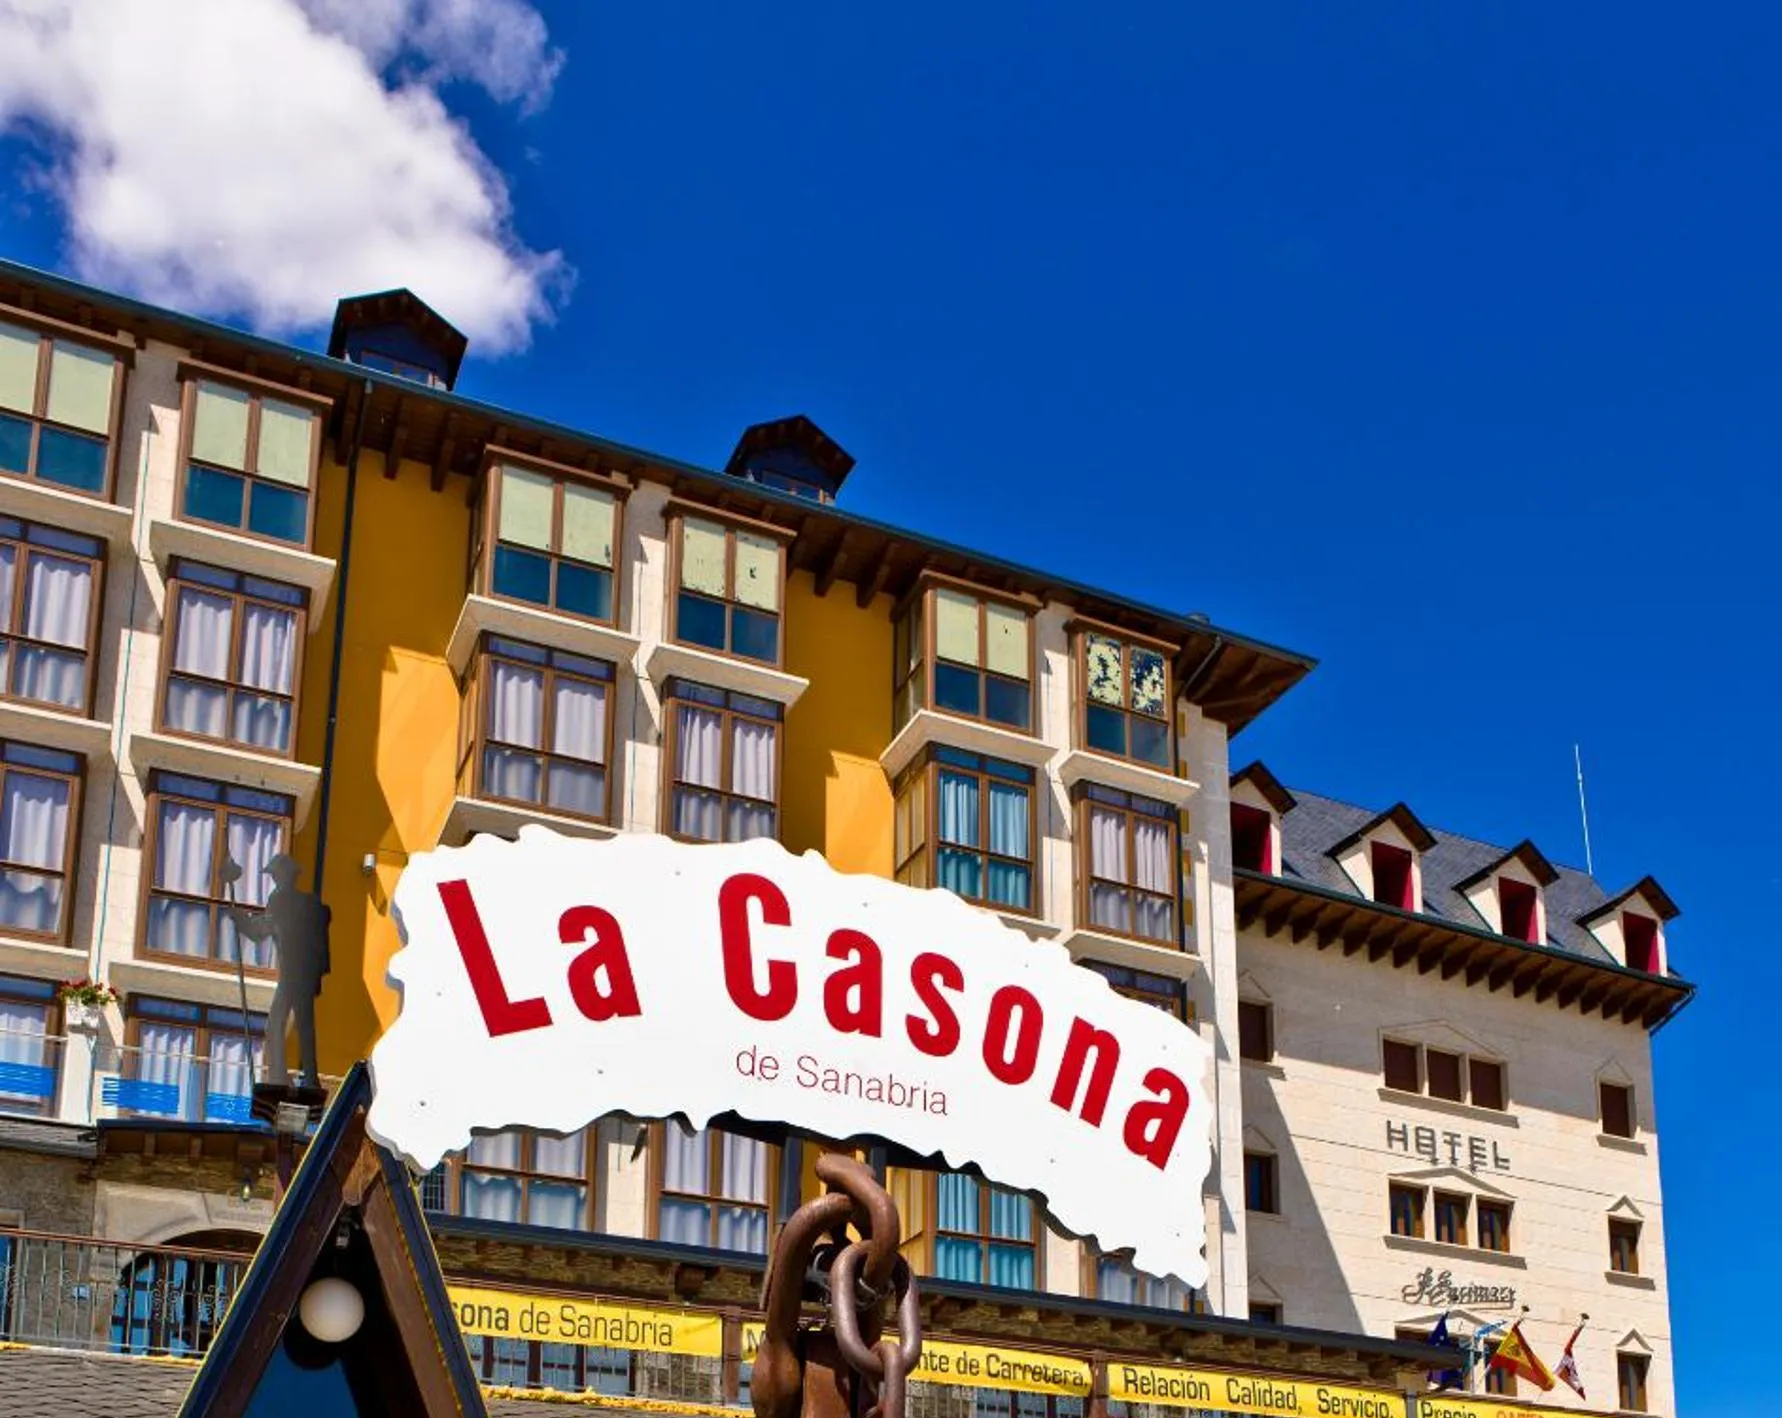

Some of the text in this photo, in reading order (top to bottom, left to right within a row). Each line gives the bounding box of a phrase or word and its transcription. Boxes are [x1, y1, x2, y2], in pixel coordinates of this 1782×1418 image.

[437, 872, 1190, 1171] La Casona
[736, 1044, 948, 1116] de Sanabria
[1385, 1119, 1511, 1172] HOTEL
[519, 1302, 551, 1335] de
[559, 1304, 673, 1347] Sanabria
[956, 1351, 980, 1377] de
[1122, 1366, 1211, 1401] Relación
[1227, 1378, 1303, 1415] Calidad,
